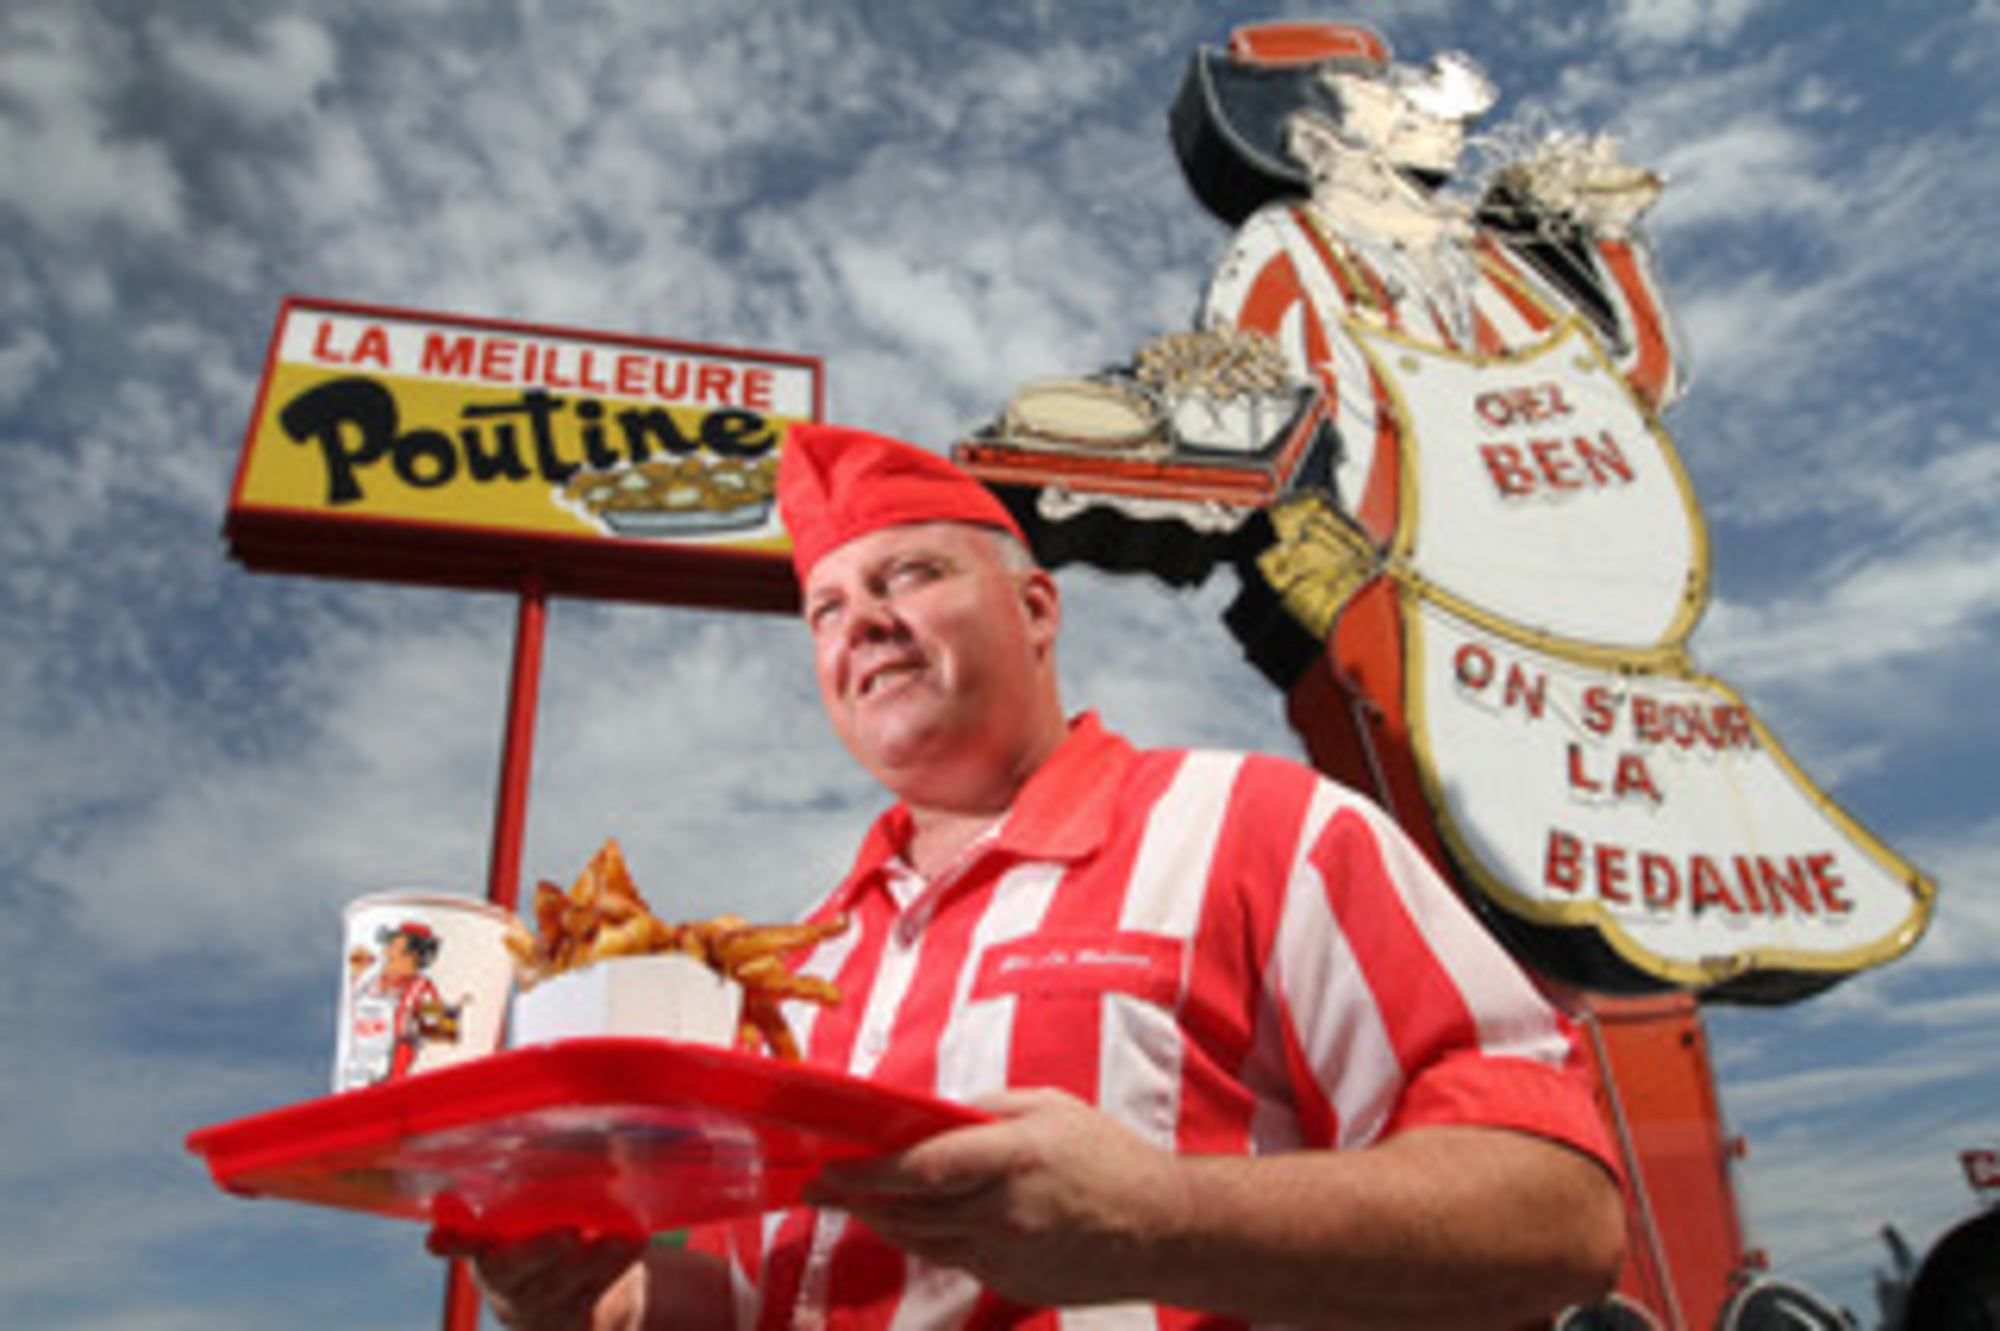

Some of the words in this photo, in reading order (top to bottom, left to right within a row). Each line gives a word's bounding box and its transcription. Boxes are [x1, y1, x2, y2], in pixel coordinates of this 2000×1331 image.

[311, 320, 391, 368] LA
[420, 331, 775, 410] MEILLEURE
[278, 376, 777, 505] Poutine
[1479, 431, 1634, 496] BEN
[1453, 644, 1546, 719] ON
[1568, 743, 1663, 803] LA
[1545, 828, 1854, 915] BEDAINE
